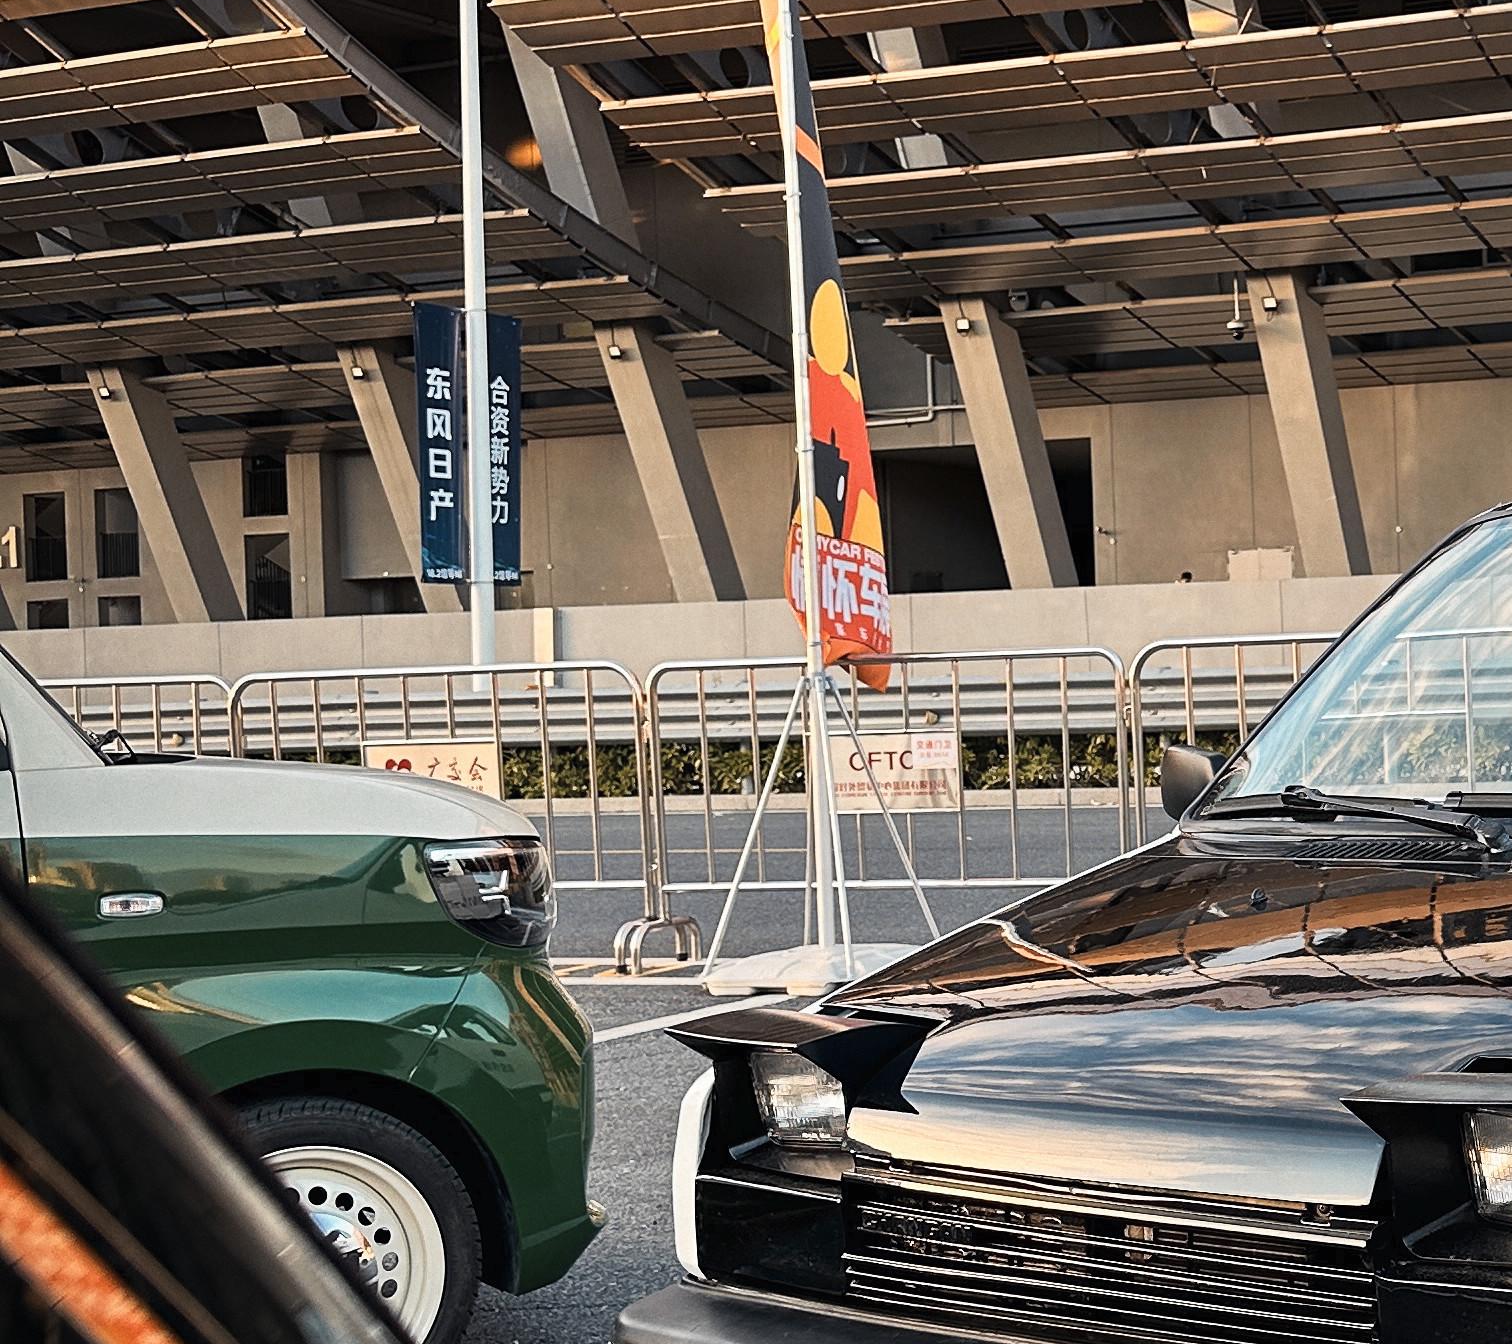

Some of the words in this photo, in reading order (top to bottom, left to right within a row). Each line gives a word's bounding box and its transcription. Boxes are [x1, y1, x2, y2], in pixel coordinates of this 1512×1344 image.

[426, 366, 455, 522] 东风日产
[489, 375, 510, 526] 合资新势力
[849, 750, 914, 772] CFTC
